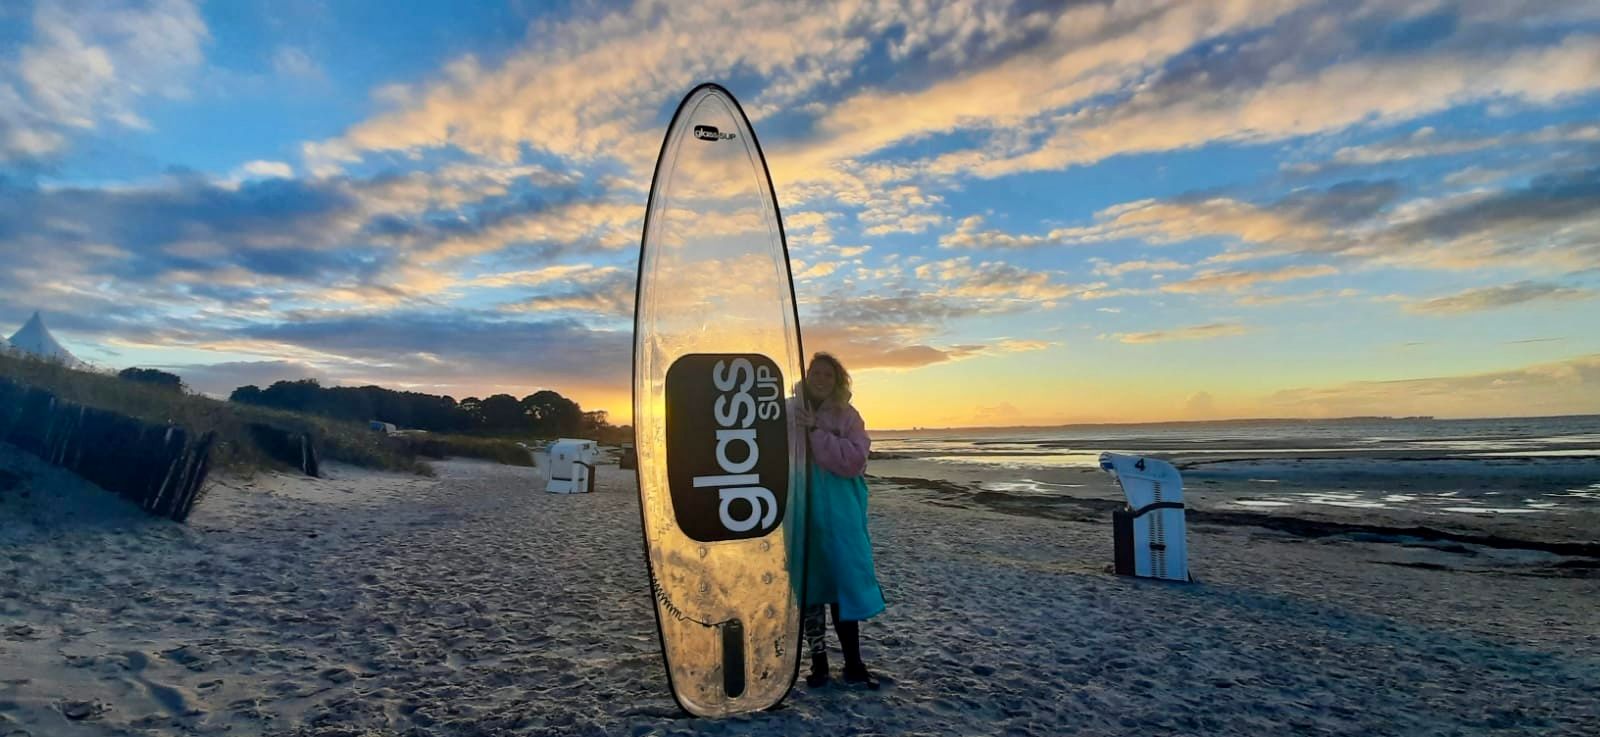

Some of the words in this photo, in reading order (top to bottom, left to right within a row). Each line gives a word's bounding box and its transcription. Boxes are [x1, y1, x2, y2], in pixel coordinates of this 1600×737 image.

[757, 365, 780, 420] SUP
[693, 358, 778, 532] glass
[1135, 458, 1145, 471] 4
